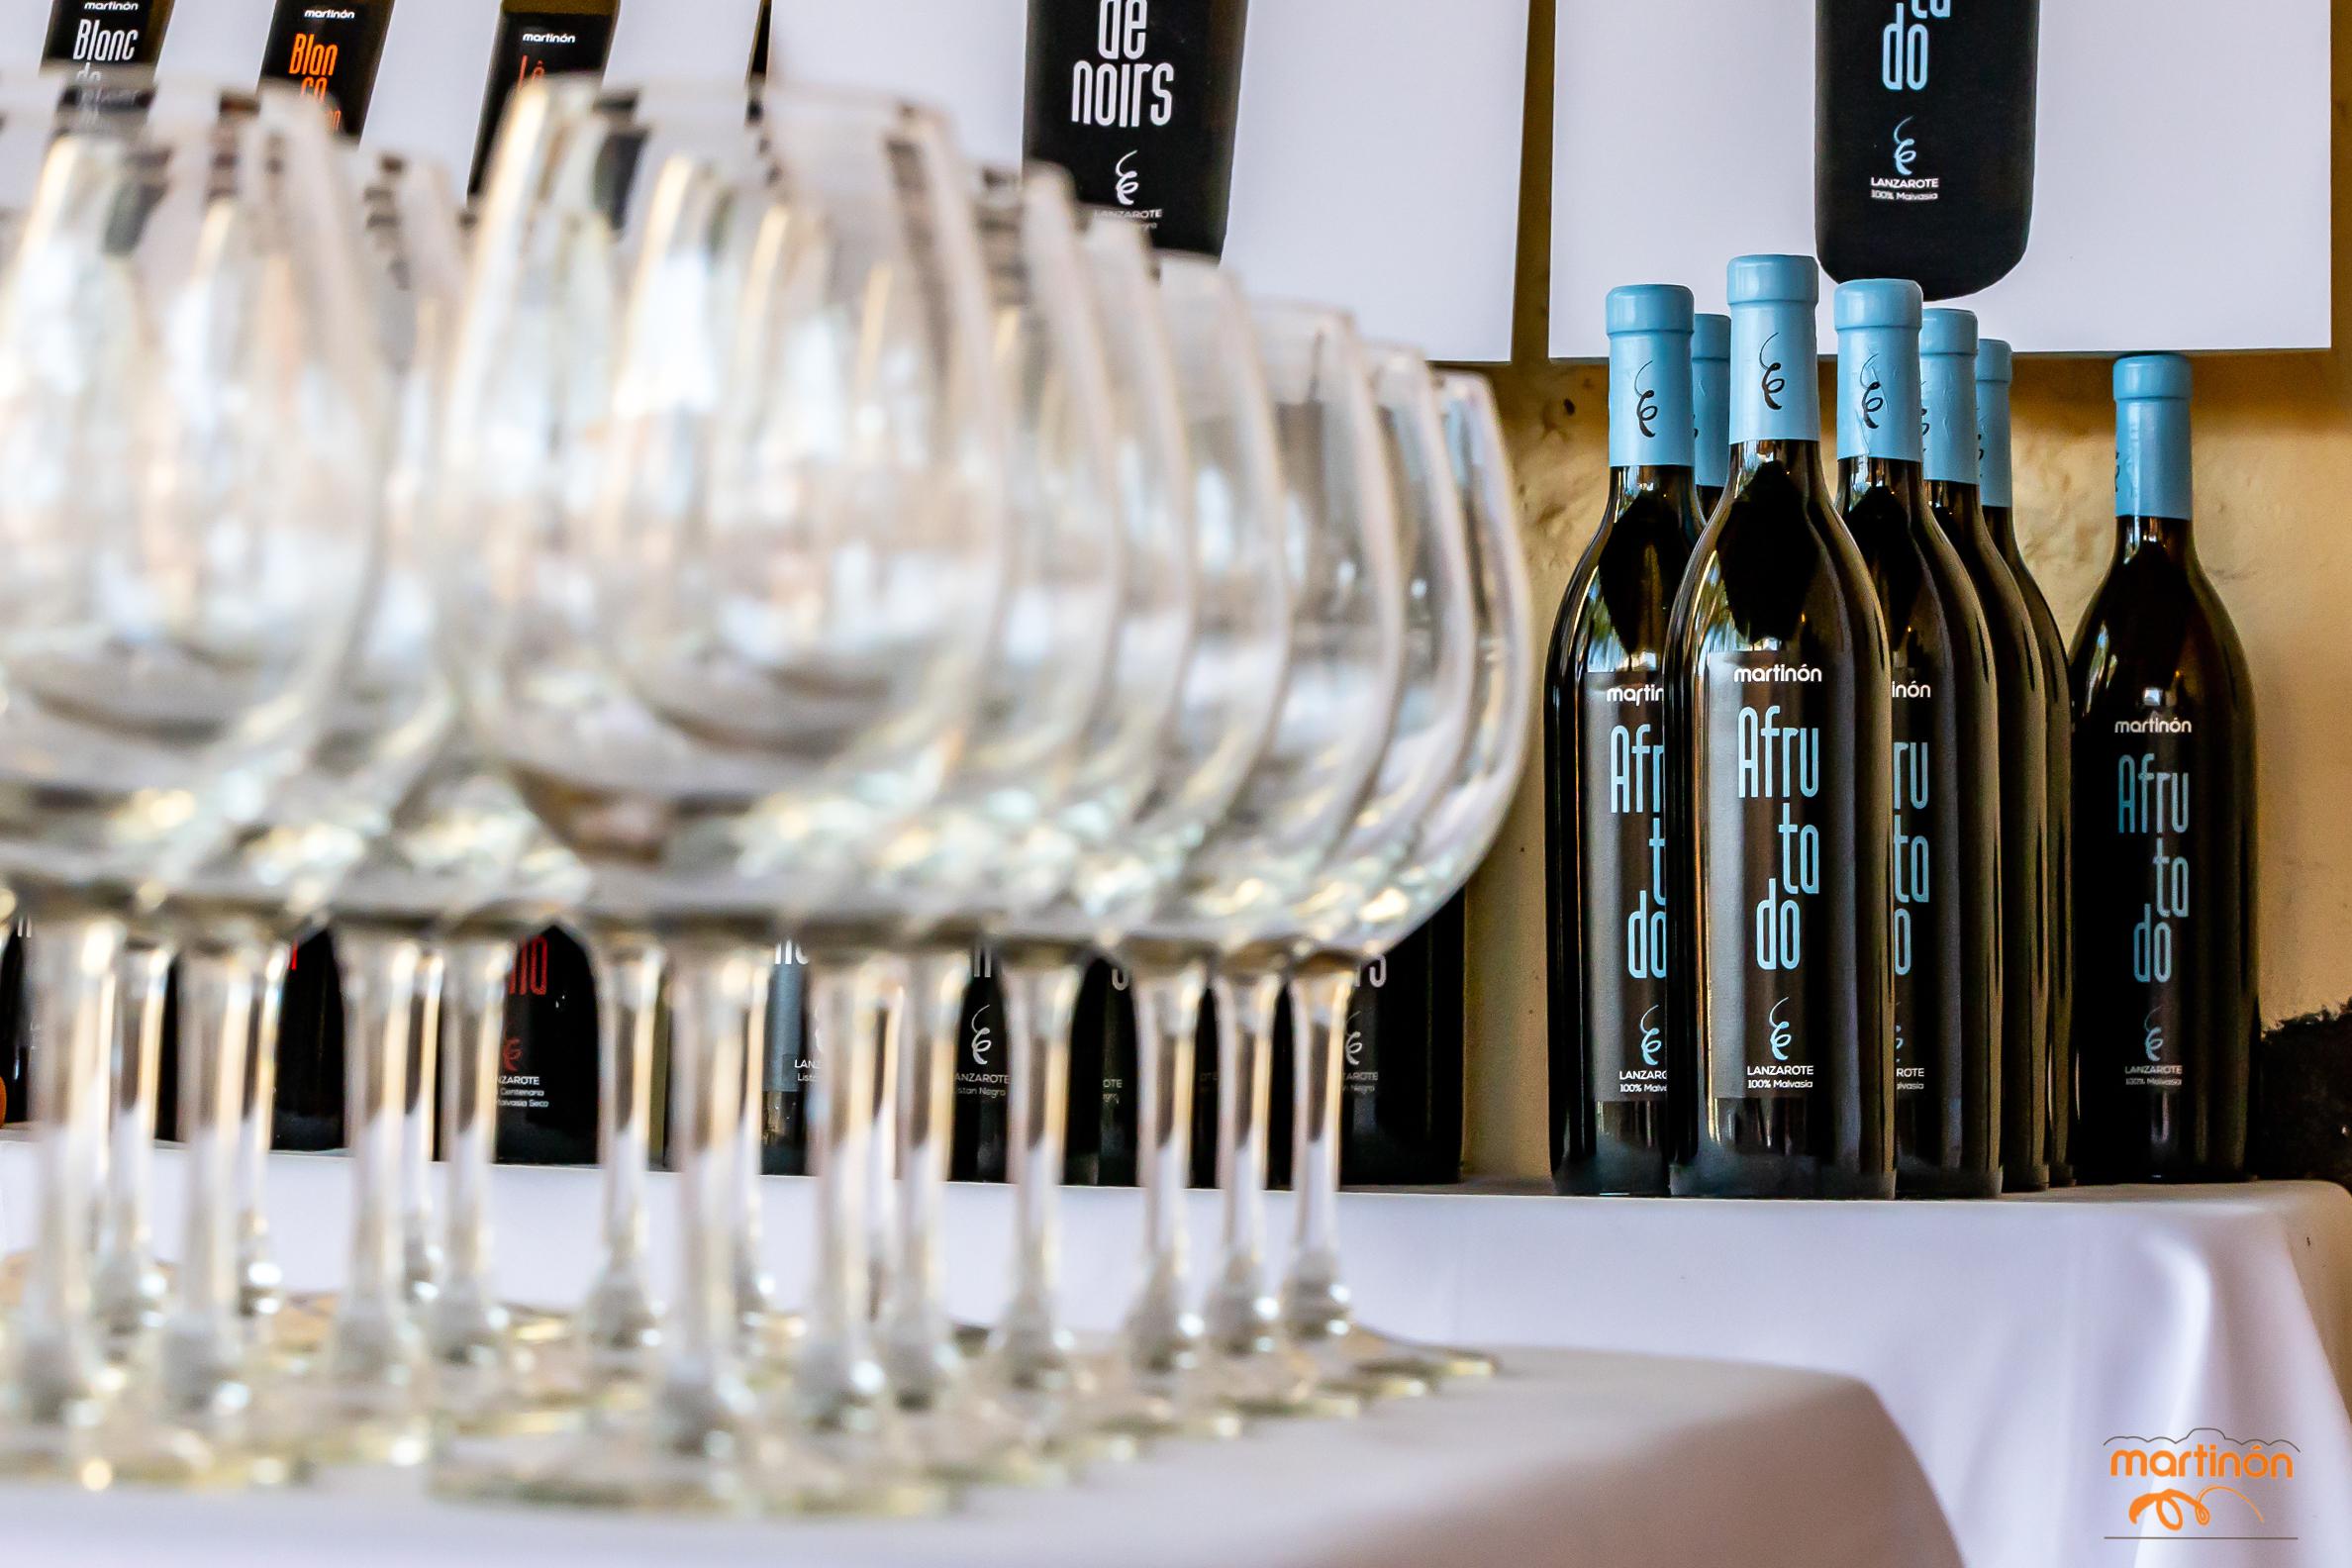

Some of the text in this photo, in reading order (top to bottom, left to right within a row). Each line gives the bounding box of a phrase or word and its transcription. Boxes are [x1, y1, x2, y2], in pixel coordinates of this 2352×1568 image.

[84, 1, 139, 11] martinón
[304, 9, 355, 19] martinón
[72, 19, 139, 61] Blanc
[522, 33, 576, 44] martinón
[1098, 0, 1147, 59] de
[1883, 2, 1928, 91] do
[288, 33, 339, 76] Blan
[1071, 60, 1174, 128] noirs
[1870, 176, 1939, 189] LANZAROTE
[1733, 664, 1822, 683] martinón
[1892, 680, 1931, 699] inón
[1606, 684, 1664, 706] martin
[2114, 716, 2193, 735] martinón
[1611, 724, 1664, 814] Afr
[1738, 705, 1819, 799] Afru
[1893, 741, 1929, 810] ru
[2117, 752, 2190, 834] Afru
[1648, 818, 1666, 906] t
[1778, 802, 1819, 895] ta
[2152, 837, 2190, 919] ta
[1627, 890, 1667, 979] do
[1755, 878, 1801, 971] do
[2133, 903, 2173, 983] do
[955, 1072, 1011, 1085] ANZAROTE
[1618, 1070, 1667, 1080] LANZAR
[1619, 1083, 1642, 1093] 100%
[1746, 1065, 1814, 1076] LANZAROTE
[1748, 1079, 1813, 1089] 100% Malvasia
[2124, 1065, 2184, 1075] LANZAROTE
